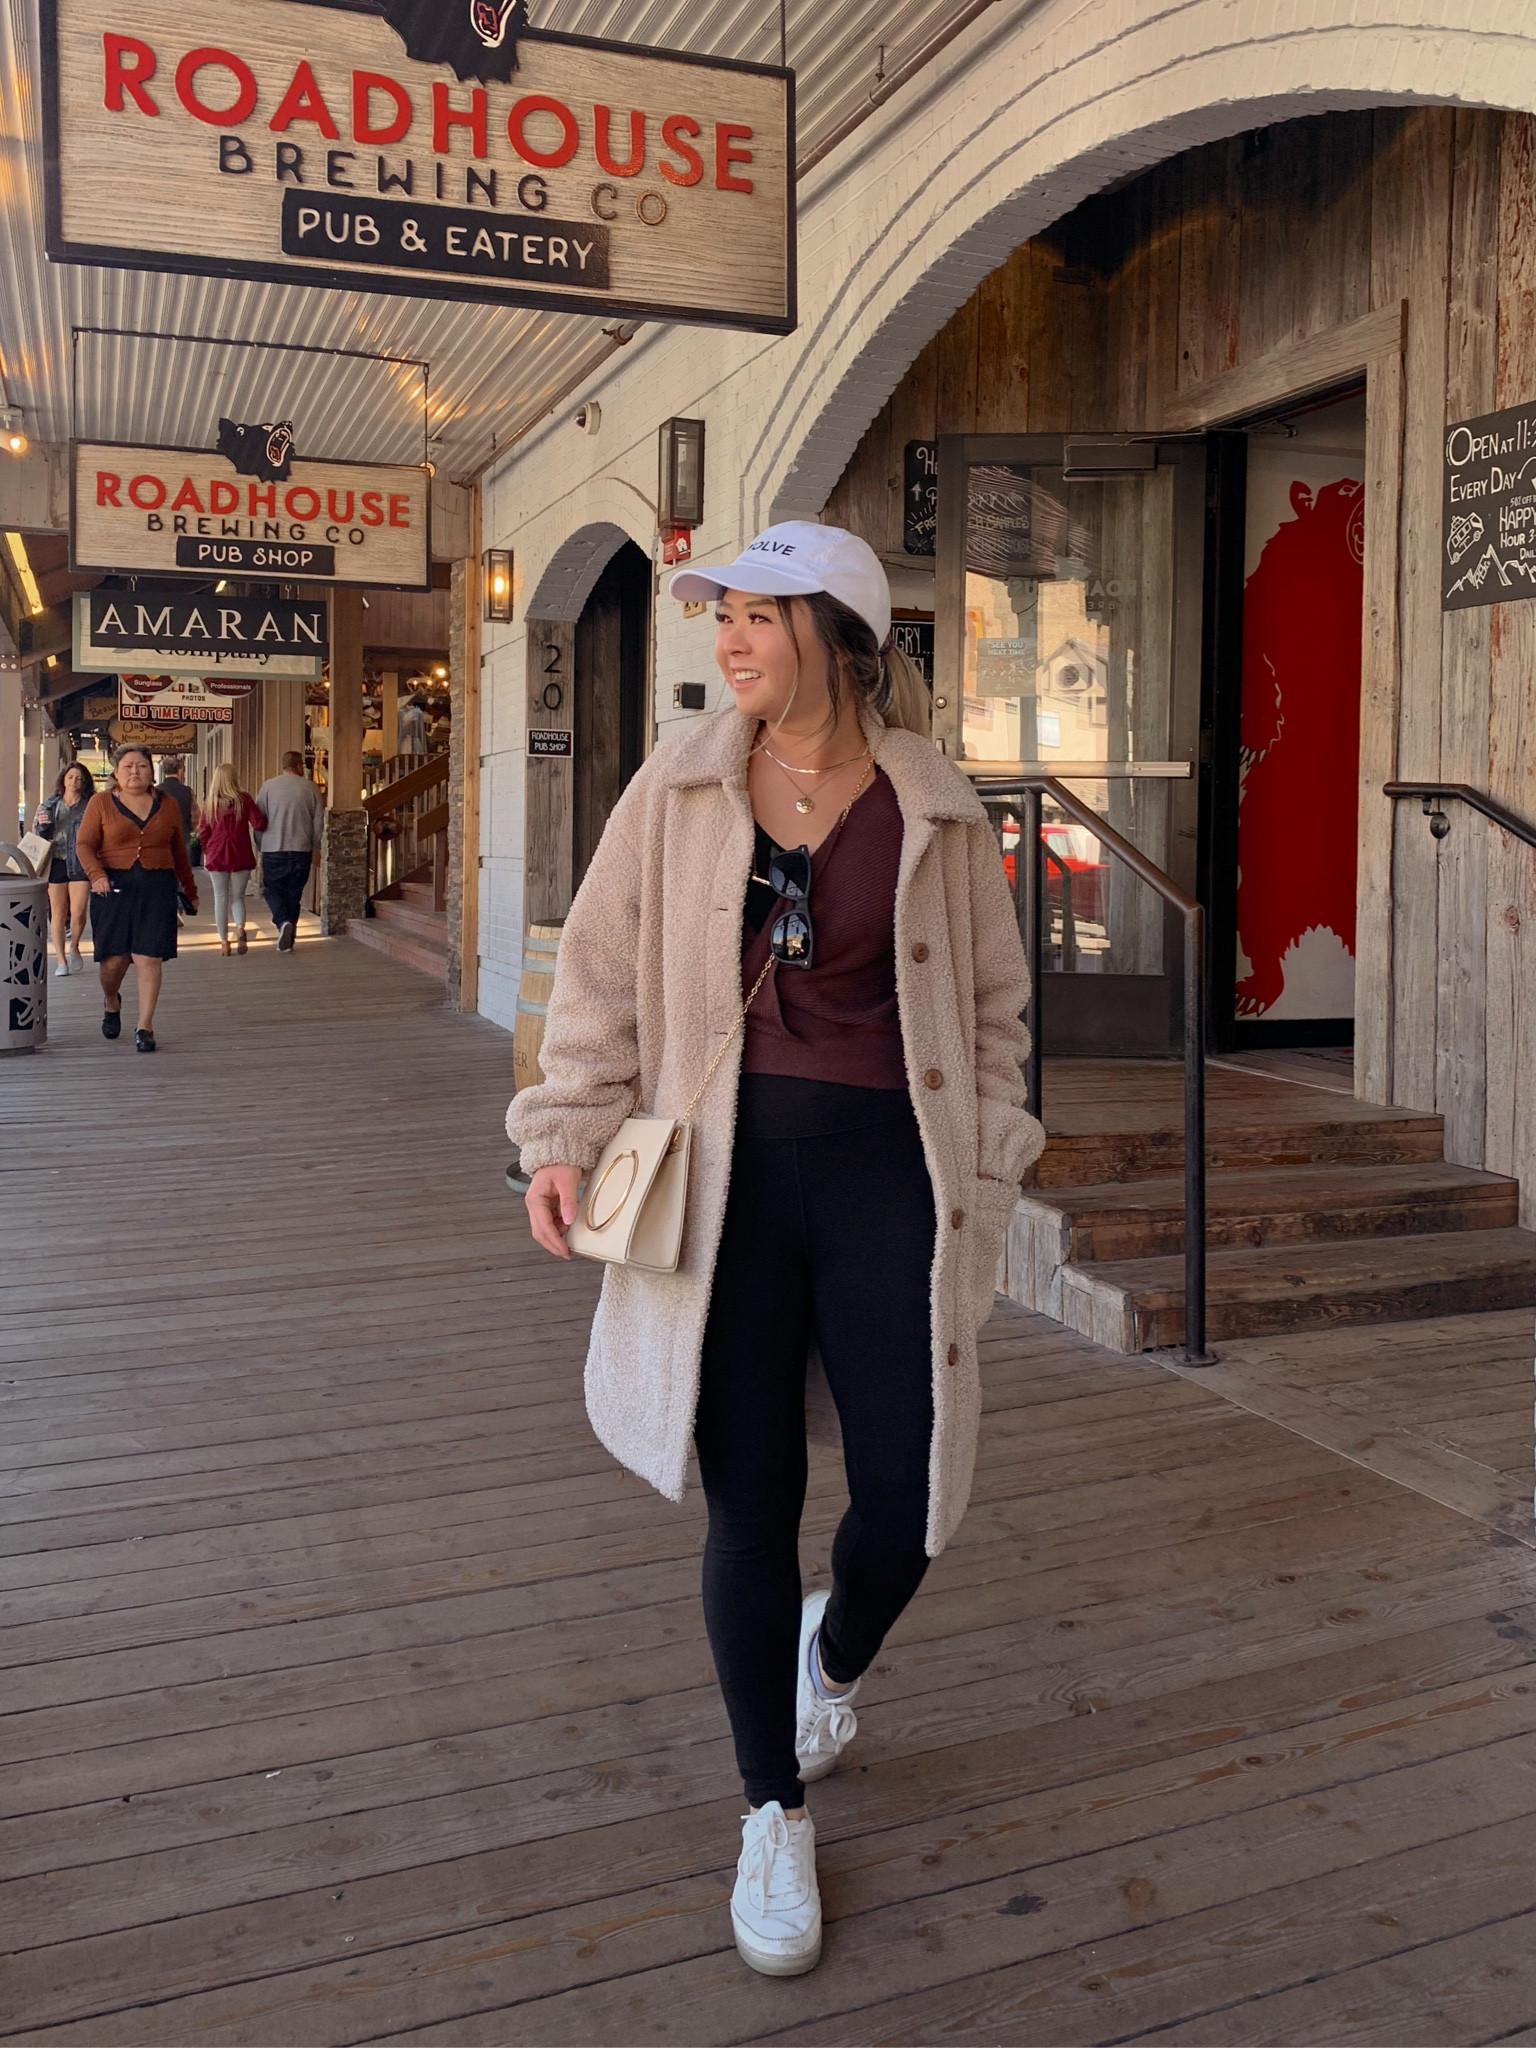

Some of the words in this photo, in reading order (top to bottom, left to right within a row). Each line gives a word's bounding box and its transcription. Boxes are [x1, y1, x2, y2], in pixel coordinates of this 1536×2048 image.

[103, 32, 754, 194] ROADHOUSE
[218, 134, 547, 212] BREWING
[590, 182, 668, 226] CO
[298, 207, 380, 247] PUB
[399, 218, 428, 253] &
[446, 225, 598, 271] EATERY
[1447, 427, 1499, 466] OPEN
[1500, 437, 1515, 454] AT
[1450, 474, 1488, 503] EVERY
[1491, 466, 1517, 494] DAY
[96, 471, 411, 528] ROADHOUSE
[148, 513, 306, 541] BREWING
[325, 526, 365, 545] CO
[915, 513, 937, 535] FRE
[1499, 506, 1536, 532] HAPPY
[1500, 532, 1525, 548] HOUR
[199, 545, 243, 563] PUB
[252, 547, 313, 566] SHOP
[1520, 548, 1536, 560] DAIL
[95, 603, 323, 644] AMARAN
[134, 679, 163, 688] Sunglass
[210, 682, 252, 691] Professionals
[122, 705, 148, 719] OLD
[150, 706, 180, 719] TIME
[182, 707, 232, 721] PHOTOS
[531, 732, 569, 741] ROADHOUSE
[534, 742, 548, 751] PUB
[549, 742, 567, 752] SHOP
